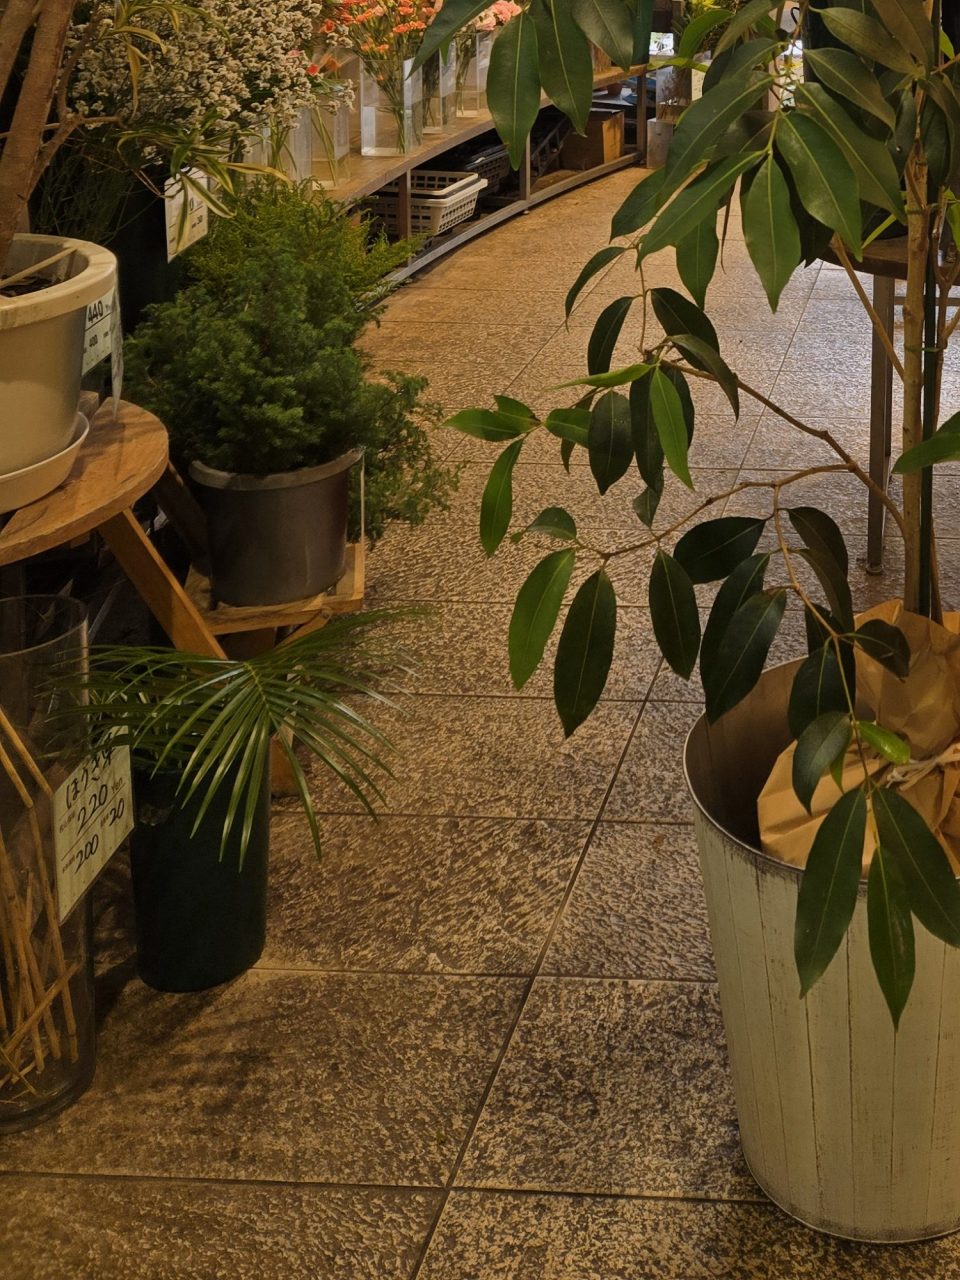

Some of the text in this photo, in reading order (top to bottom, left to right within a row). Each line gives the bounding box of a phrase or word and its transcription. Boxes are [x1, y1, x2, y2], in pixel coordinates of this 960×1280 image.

[88, 300, 104, 324] 440
[77, 783, 108, 837] 220
[108, 797, 125, 827] 20
[74, 833, 100, 874] 200
